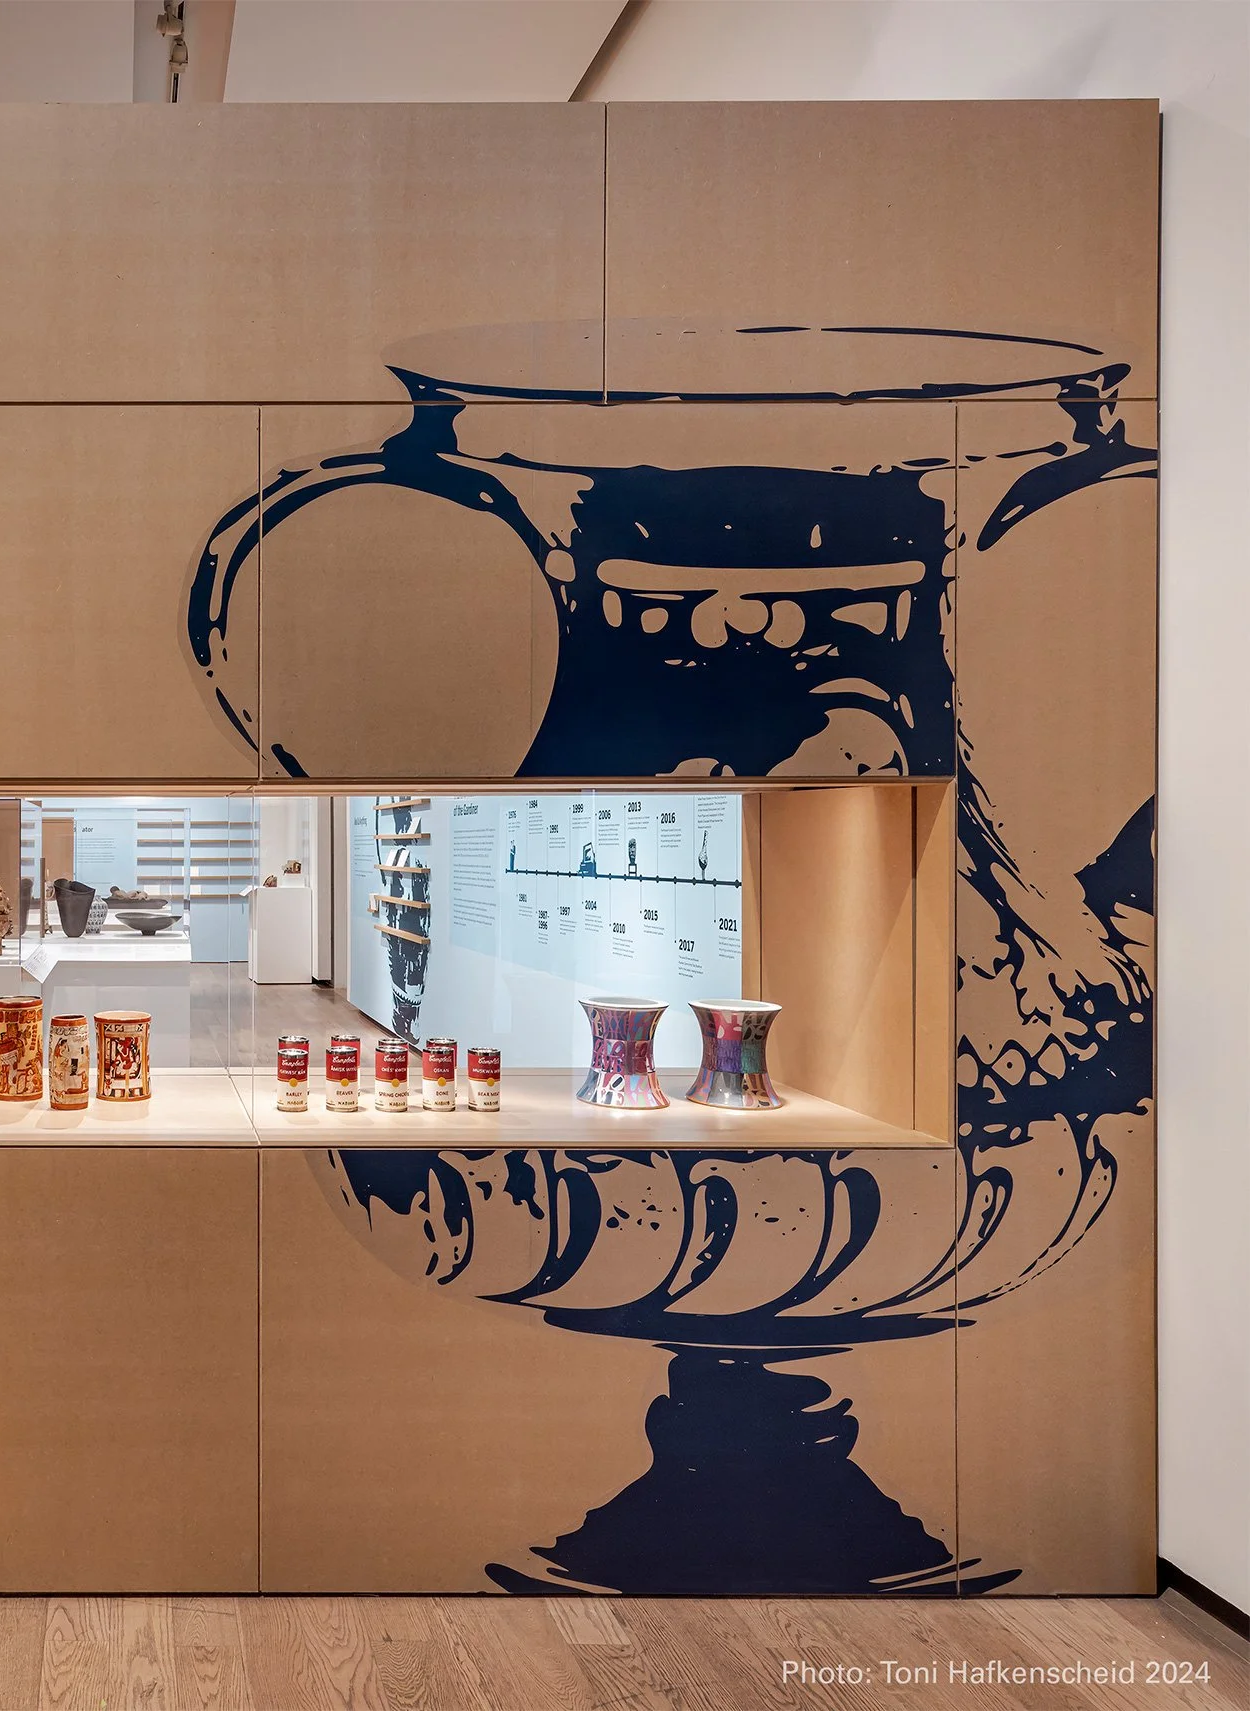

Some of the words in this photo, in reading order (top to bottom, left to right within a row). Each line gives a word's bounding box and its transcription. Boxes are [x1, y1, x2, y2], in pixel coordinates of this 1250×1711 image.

[572, 803, 584, 813] 1999
[627, 801, 642, 813] 2013
[598, 809, 611, 820] 2006
[660, 812, 676, 824] 2016
[584, 900, 597, 911] 2004
[643, 909, 659, 921] 2015
[612, 922, 626, 934] 2010
[718, 918, 737, 932] 2021
[678, 938, 695, 952] 2017
